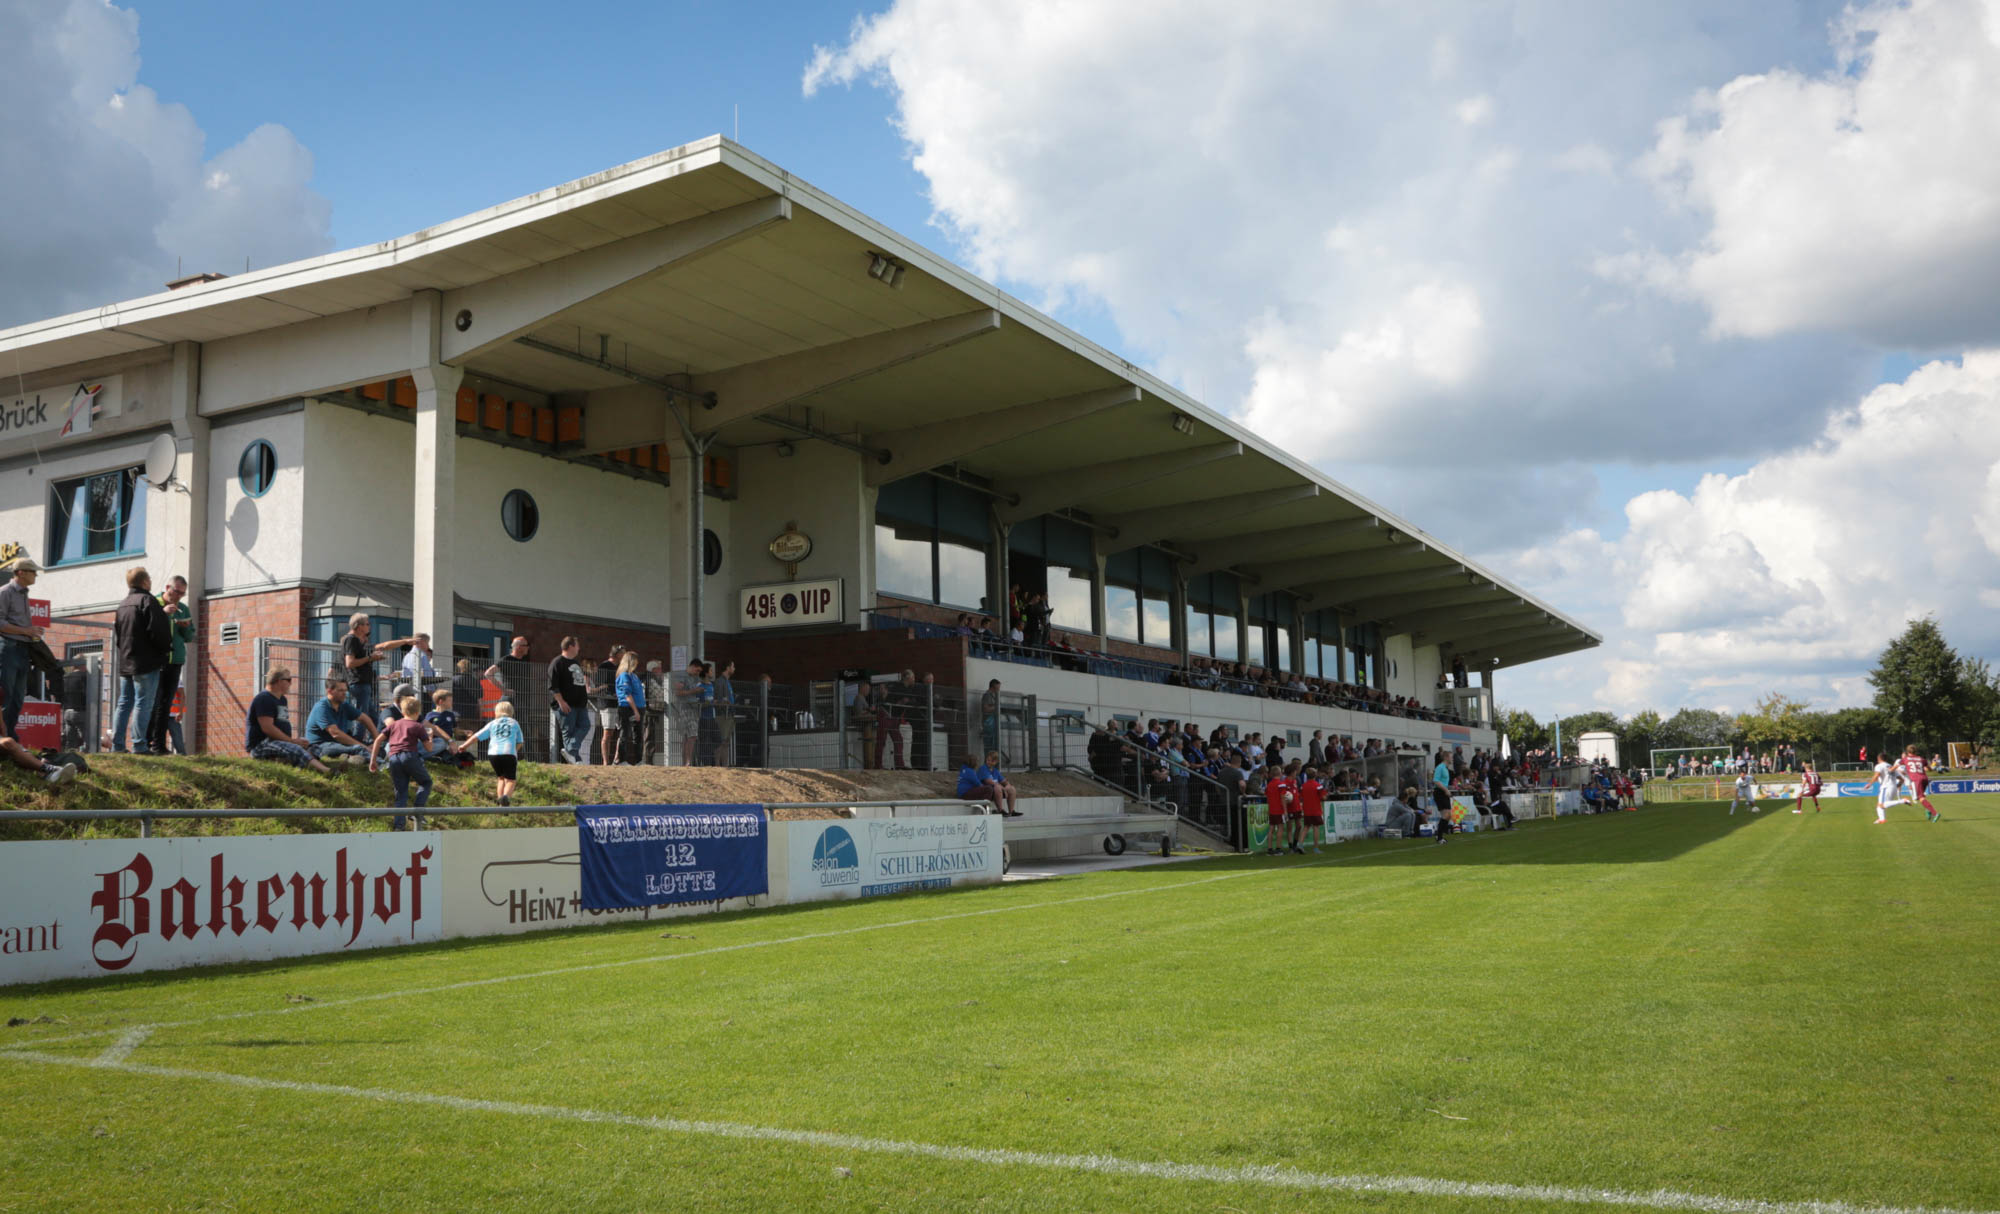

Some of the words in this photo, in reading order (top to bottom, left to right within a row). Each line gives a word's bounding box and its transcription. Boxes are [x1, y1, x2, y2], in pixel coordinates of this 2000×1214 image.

[801, 588, 831, 615] VIP
[17, 711, 57, 727] eimspiel
[1907, 761, 1923, 773] 33
[586, 813, 759, 844] WELLENBRECHER
[917, 828, 929, 837] von
[665, 843, 696, 867] 12
[812, 857, 839, 872] salon
[646, 871, 716, 896] LOTTE
[91, 844, 434, 970] Bakenhof
[0, 917, 64, 954] ant
